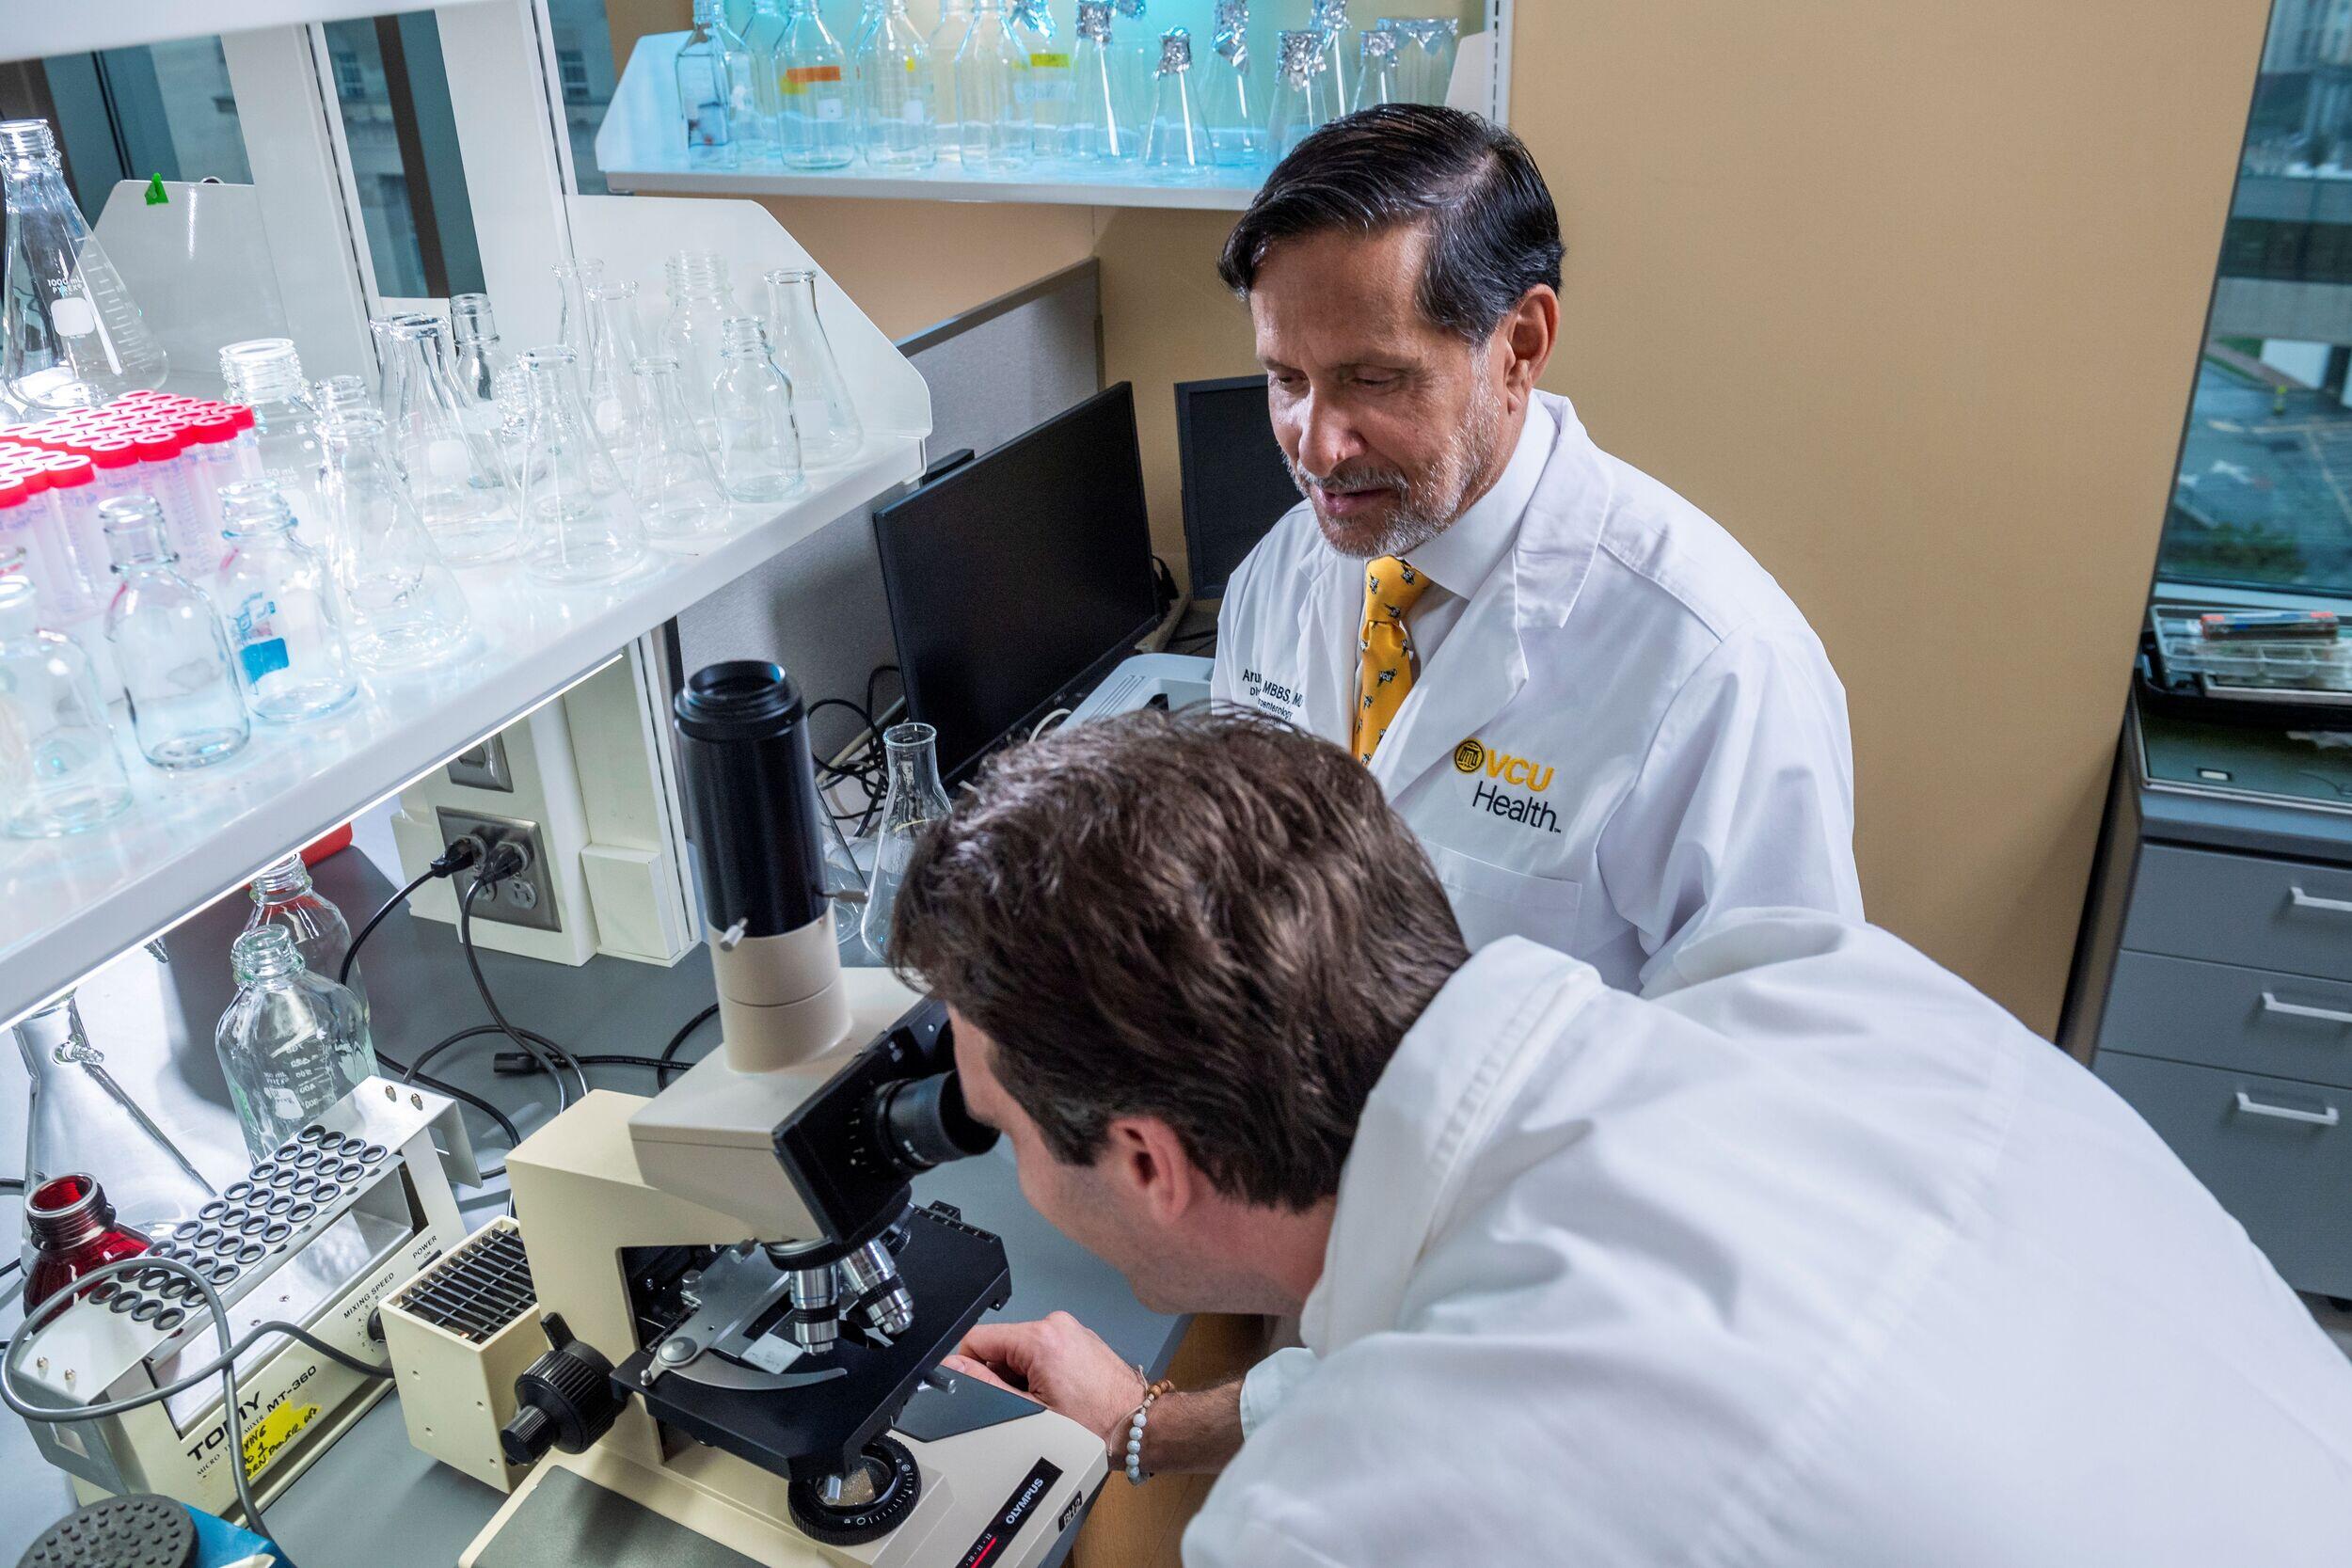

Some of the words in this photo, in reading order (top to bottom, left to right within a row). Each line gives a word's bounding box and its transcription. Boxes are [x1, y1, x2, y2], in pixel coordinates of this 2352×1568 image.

[1262, 680, 1291, 705] MBBS,
[1486, 748, 1555, 792] VCU
[1471, 780, 1557, 832] Health
[412, 1235, 438, 1259] POWER
[342, 1292, 372, 1320] MIXING
[371, 1271, 395, 1295] SPEED
[266, 1365, 317, 1413] MT-360
[1006, 1477, 1044, 1525] OLYMPUS
